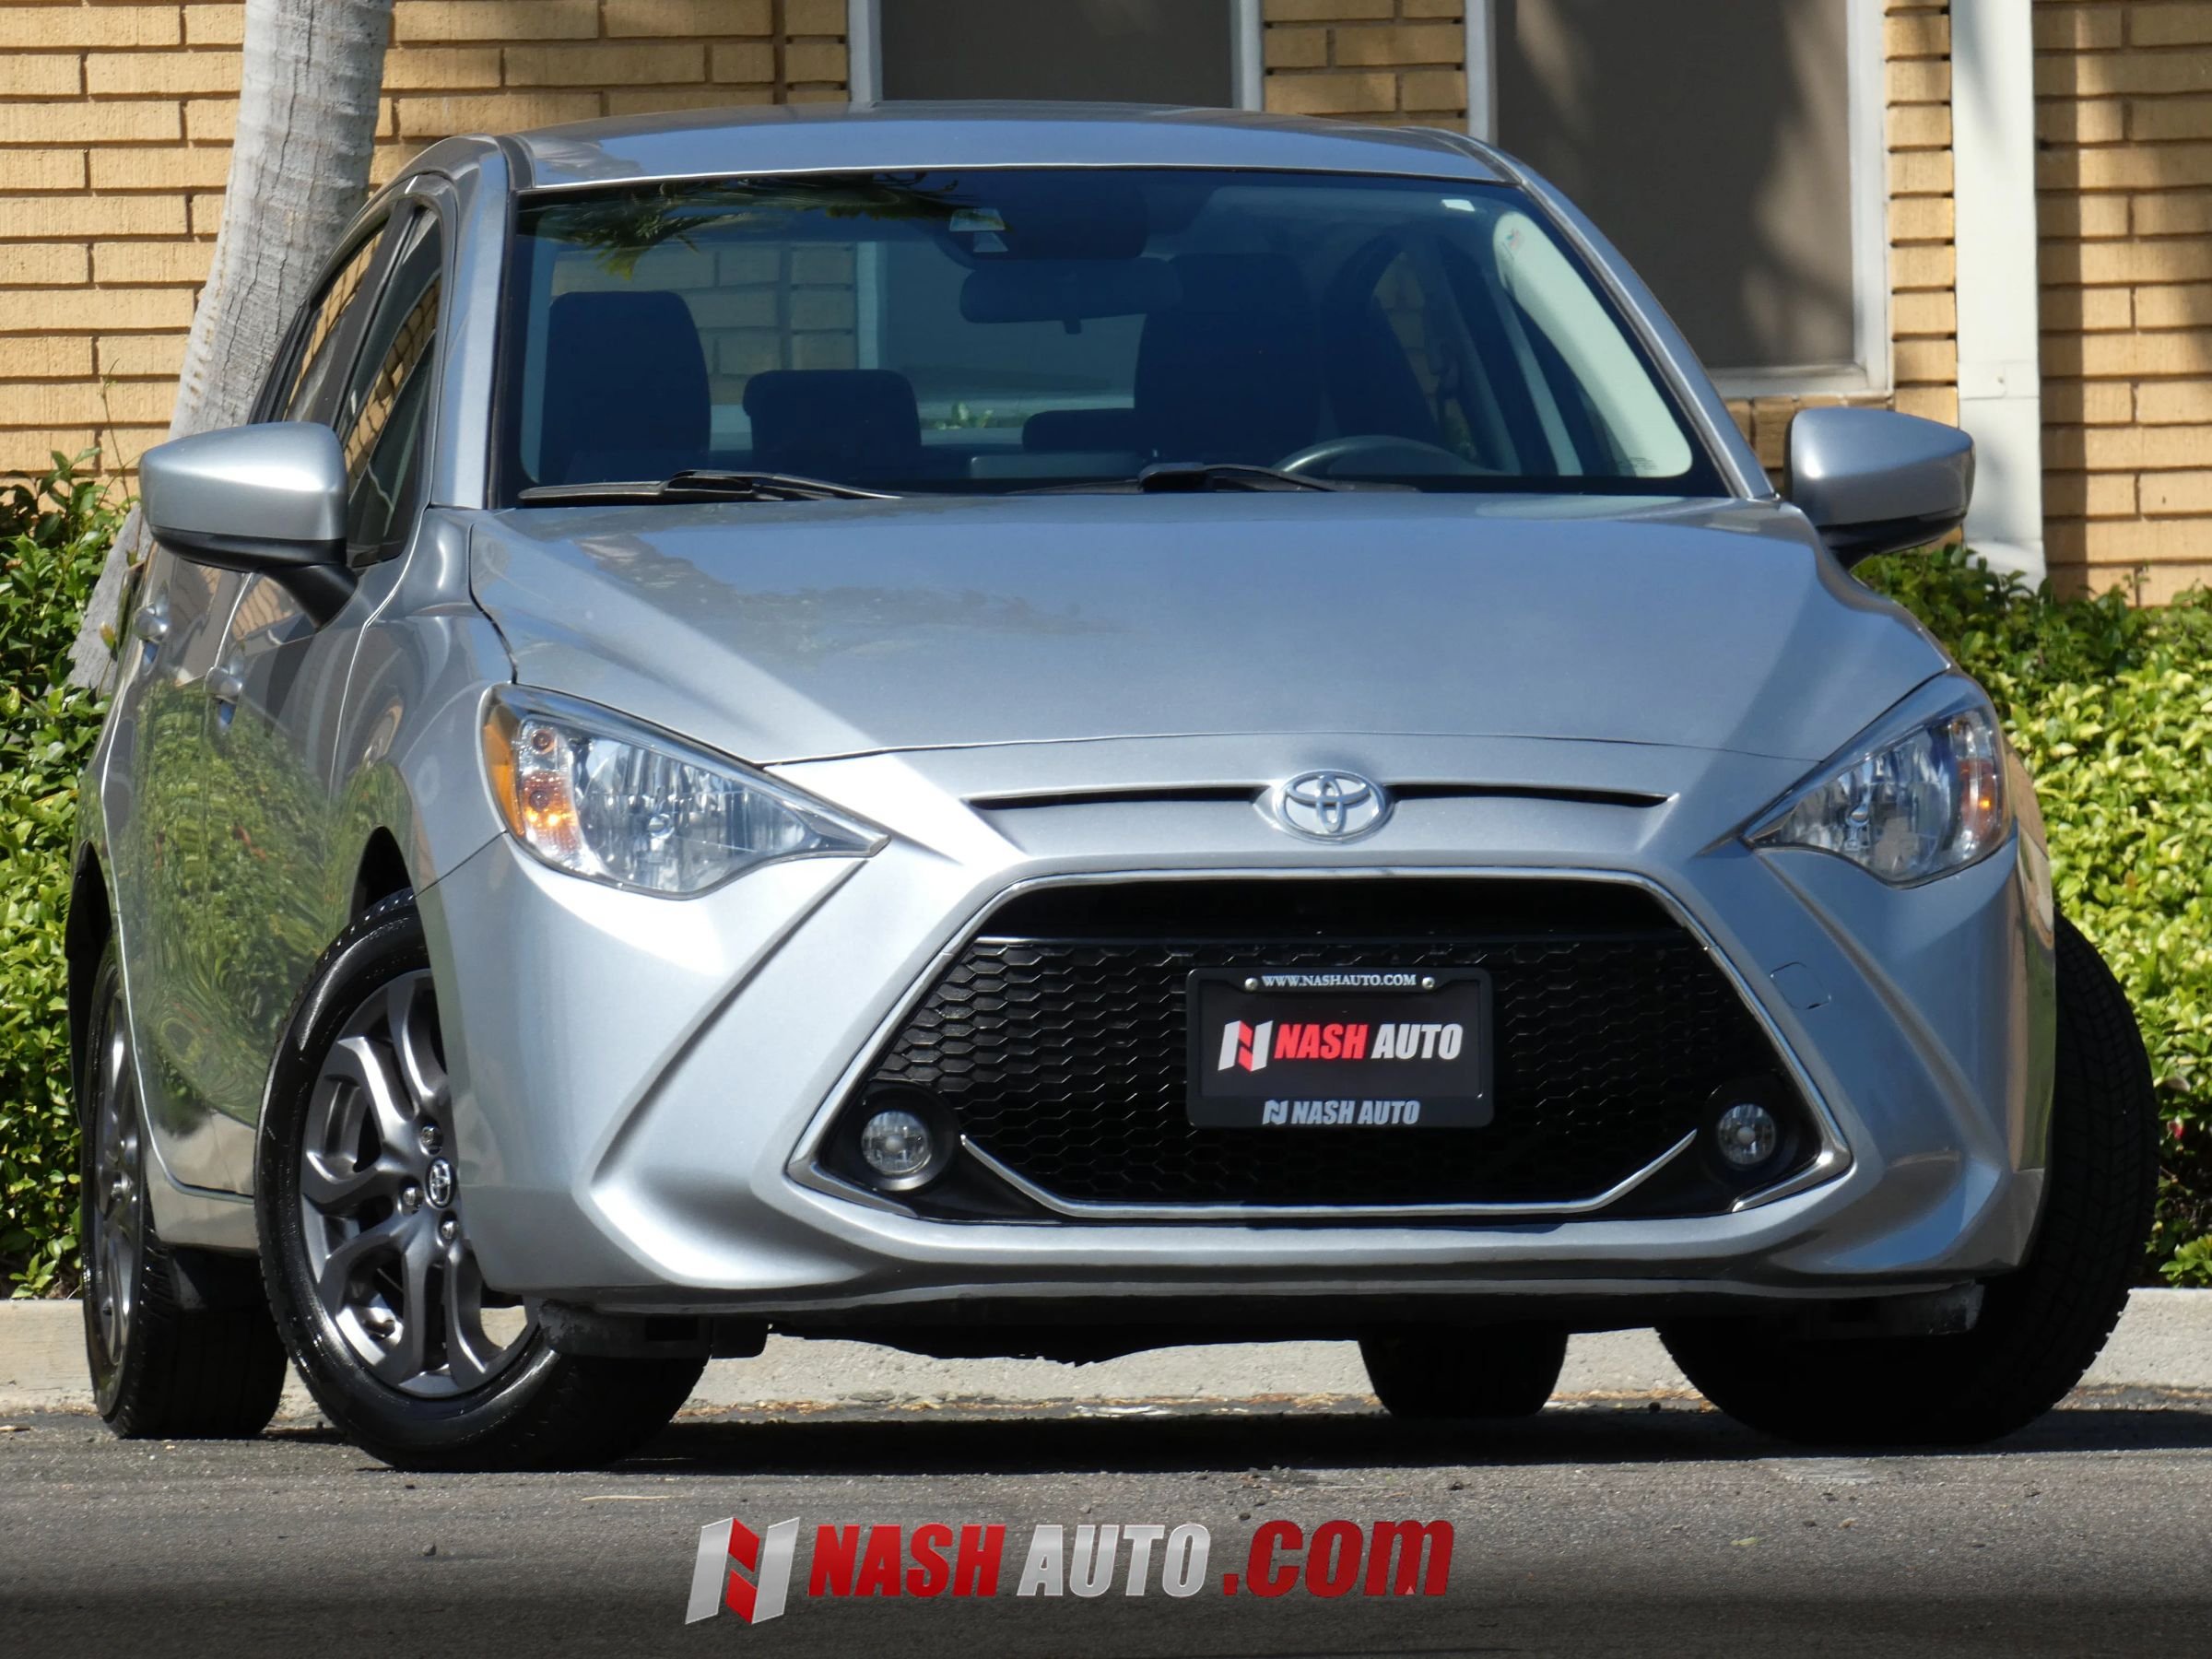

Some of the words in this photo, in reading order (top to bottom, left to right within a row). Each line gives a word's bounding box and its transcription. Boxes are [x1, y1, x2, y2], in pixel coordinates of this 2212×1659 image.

[1261, 973, 1417, 987] WWW.NASHAUTO.COM
[1273, 1023, 1370, 1060] NASH
[1371, 1023, 1464, 1060] AUTO
[1290, 1100, 1356, 1125] NASH
[1357, 1100, 1420, 1125] AUTO
